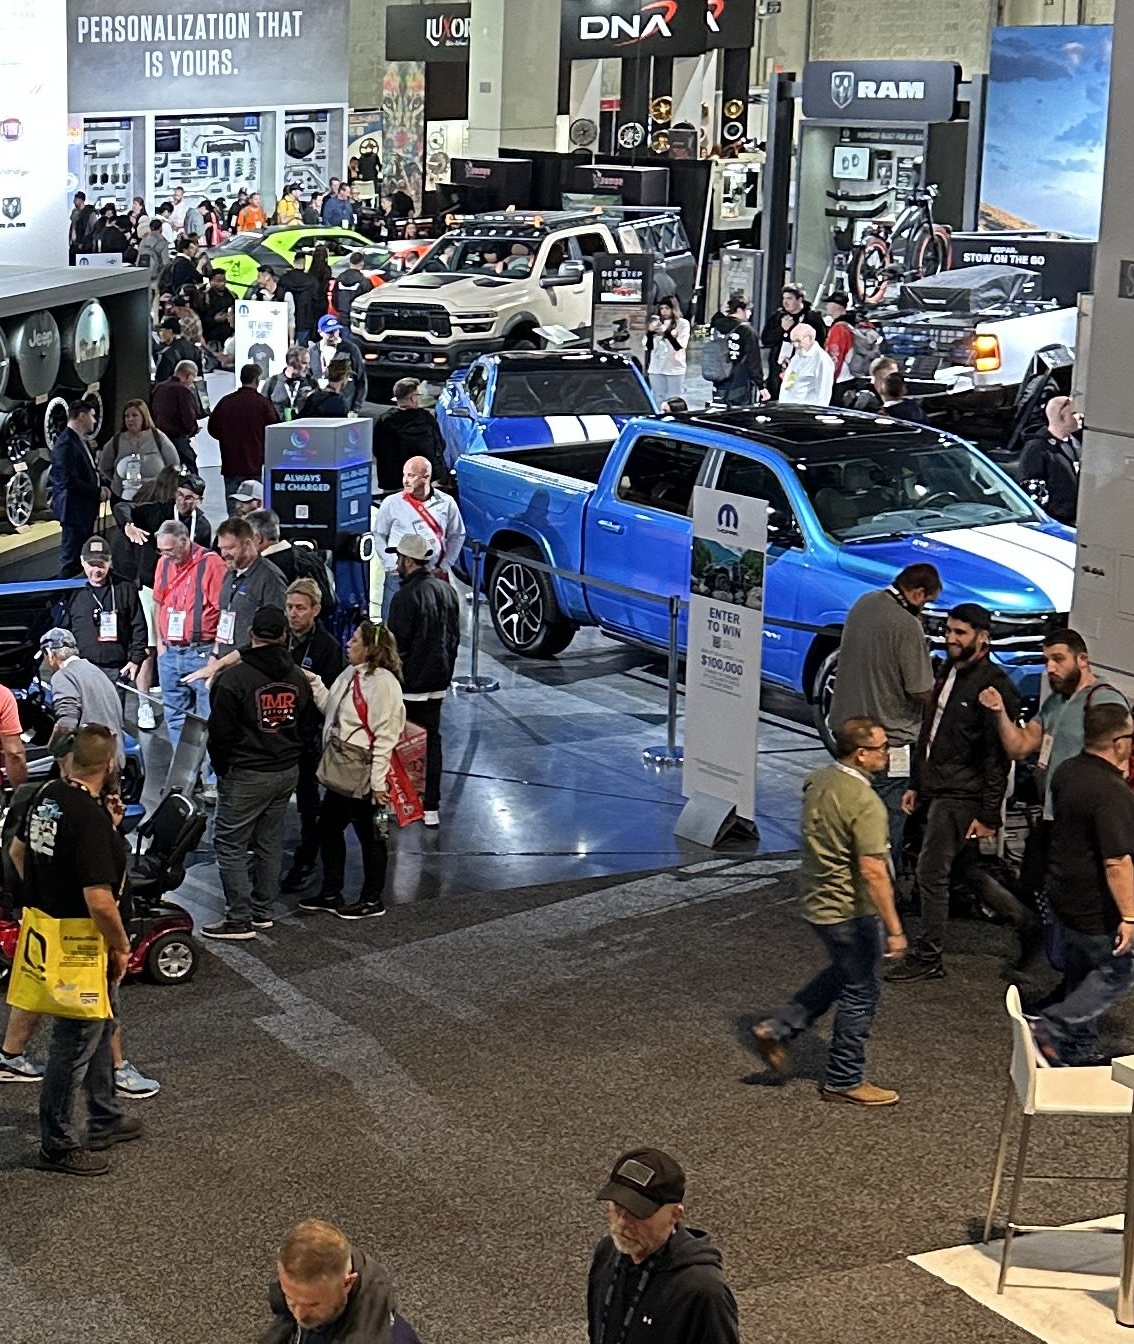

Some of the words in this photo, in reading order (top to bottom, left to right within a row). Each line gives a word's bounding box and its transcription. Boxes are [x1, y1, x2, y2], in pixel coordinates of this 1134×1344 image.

[77, 12, 250, 44] PERSONALIZATION
[255, 10, 303, 38] THAT
[579, 14, 672, 40] DNA
[144, 51, 164, 78] IS
[169, 48, 239, 78] YOURS.
[857, 81, 925, 99] RAM
[963, 252, 992, 263] STOW
[993, 254, 1008, 264] ON
[1010, 254, 1029, 265] THE
[1030, 255, 1045, 266] GO
[28, 328, 53, 348] Jeep
[274, 483, 285, 491] BE
[287, 483, 331, 492] CHARGED
[283, 474, 321, 483] ALWAYS
[709, 607, 740, 625] ENTER
[707, 619, 720, 633] TO
[722, 623, 742, 639] WIN
[701, 654, 744, 676] $100,000
